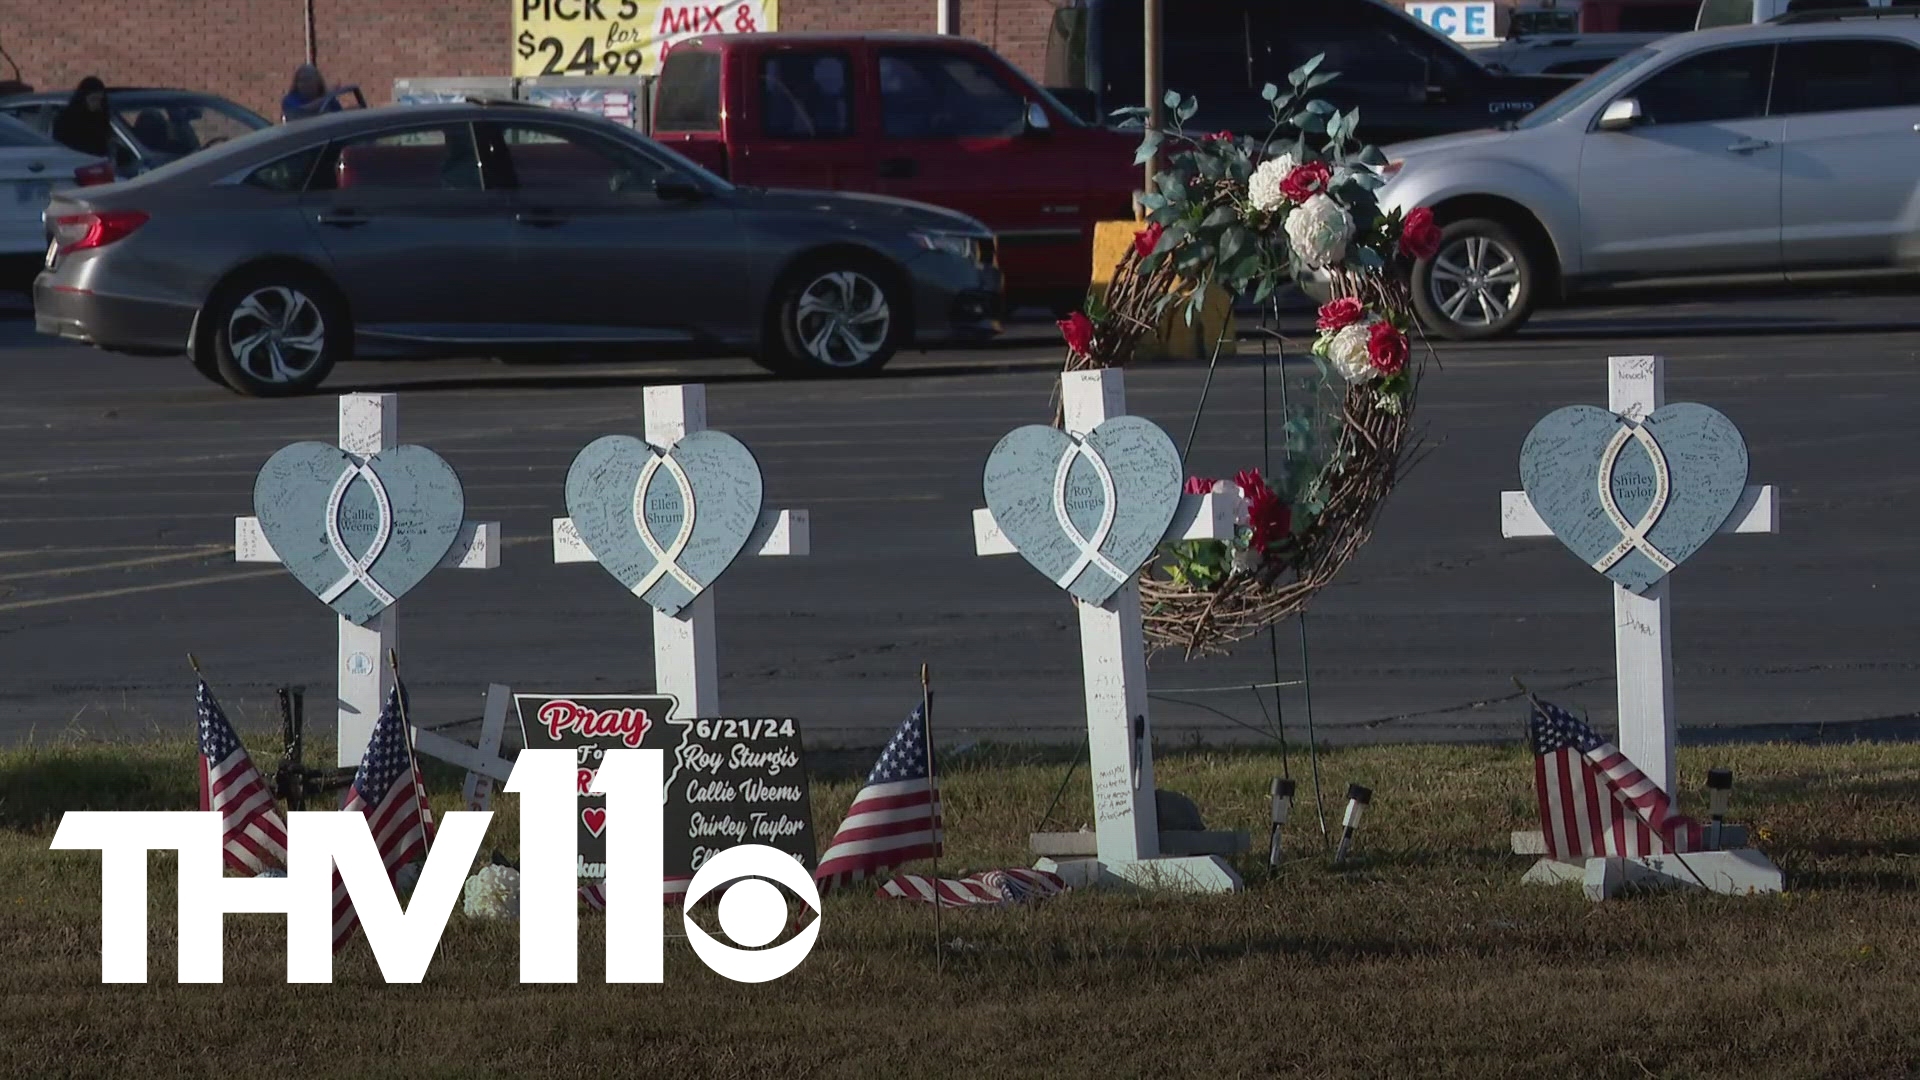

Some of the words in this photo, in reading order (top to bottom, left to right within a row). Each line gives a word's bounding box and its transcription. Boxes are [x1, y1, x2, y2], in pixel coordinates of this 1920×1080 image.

[522, 0, 606, 21] PICK
[618, 0, 638, 20] 5
[660, 5, 724, 34] MIX
[735, 4, 758, 33] &
[606, 22, 641, 49] for
[1615, 474, 1653, 487] Shirley
[1074, 486, 1092, 497] Roy
[1617, 486, 1652, 500] Taylor
[651, 499, 678, 510] Ellen
[1067, 497, 1104, 510] Sturgis
[344, 509, 375, 520] Callie
[648, 512, 683, 523] Shrum
[341, 520, 378, 531] Weems
[539, 700, 651, 748] Pray
[696, 719, 795, 740] 6/21/24
[577, 743, 607, 765] Fo
[684, 743, 725, 774] Roy
[728, 744, 798, 775] Sturgis
[686, 775, 738, 803] Callie
[742, 776, 801, 803] Weems
[689, 812, 747, 842] Shirley
[751, 813, 804, 841] Taylor
